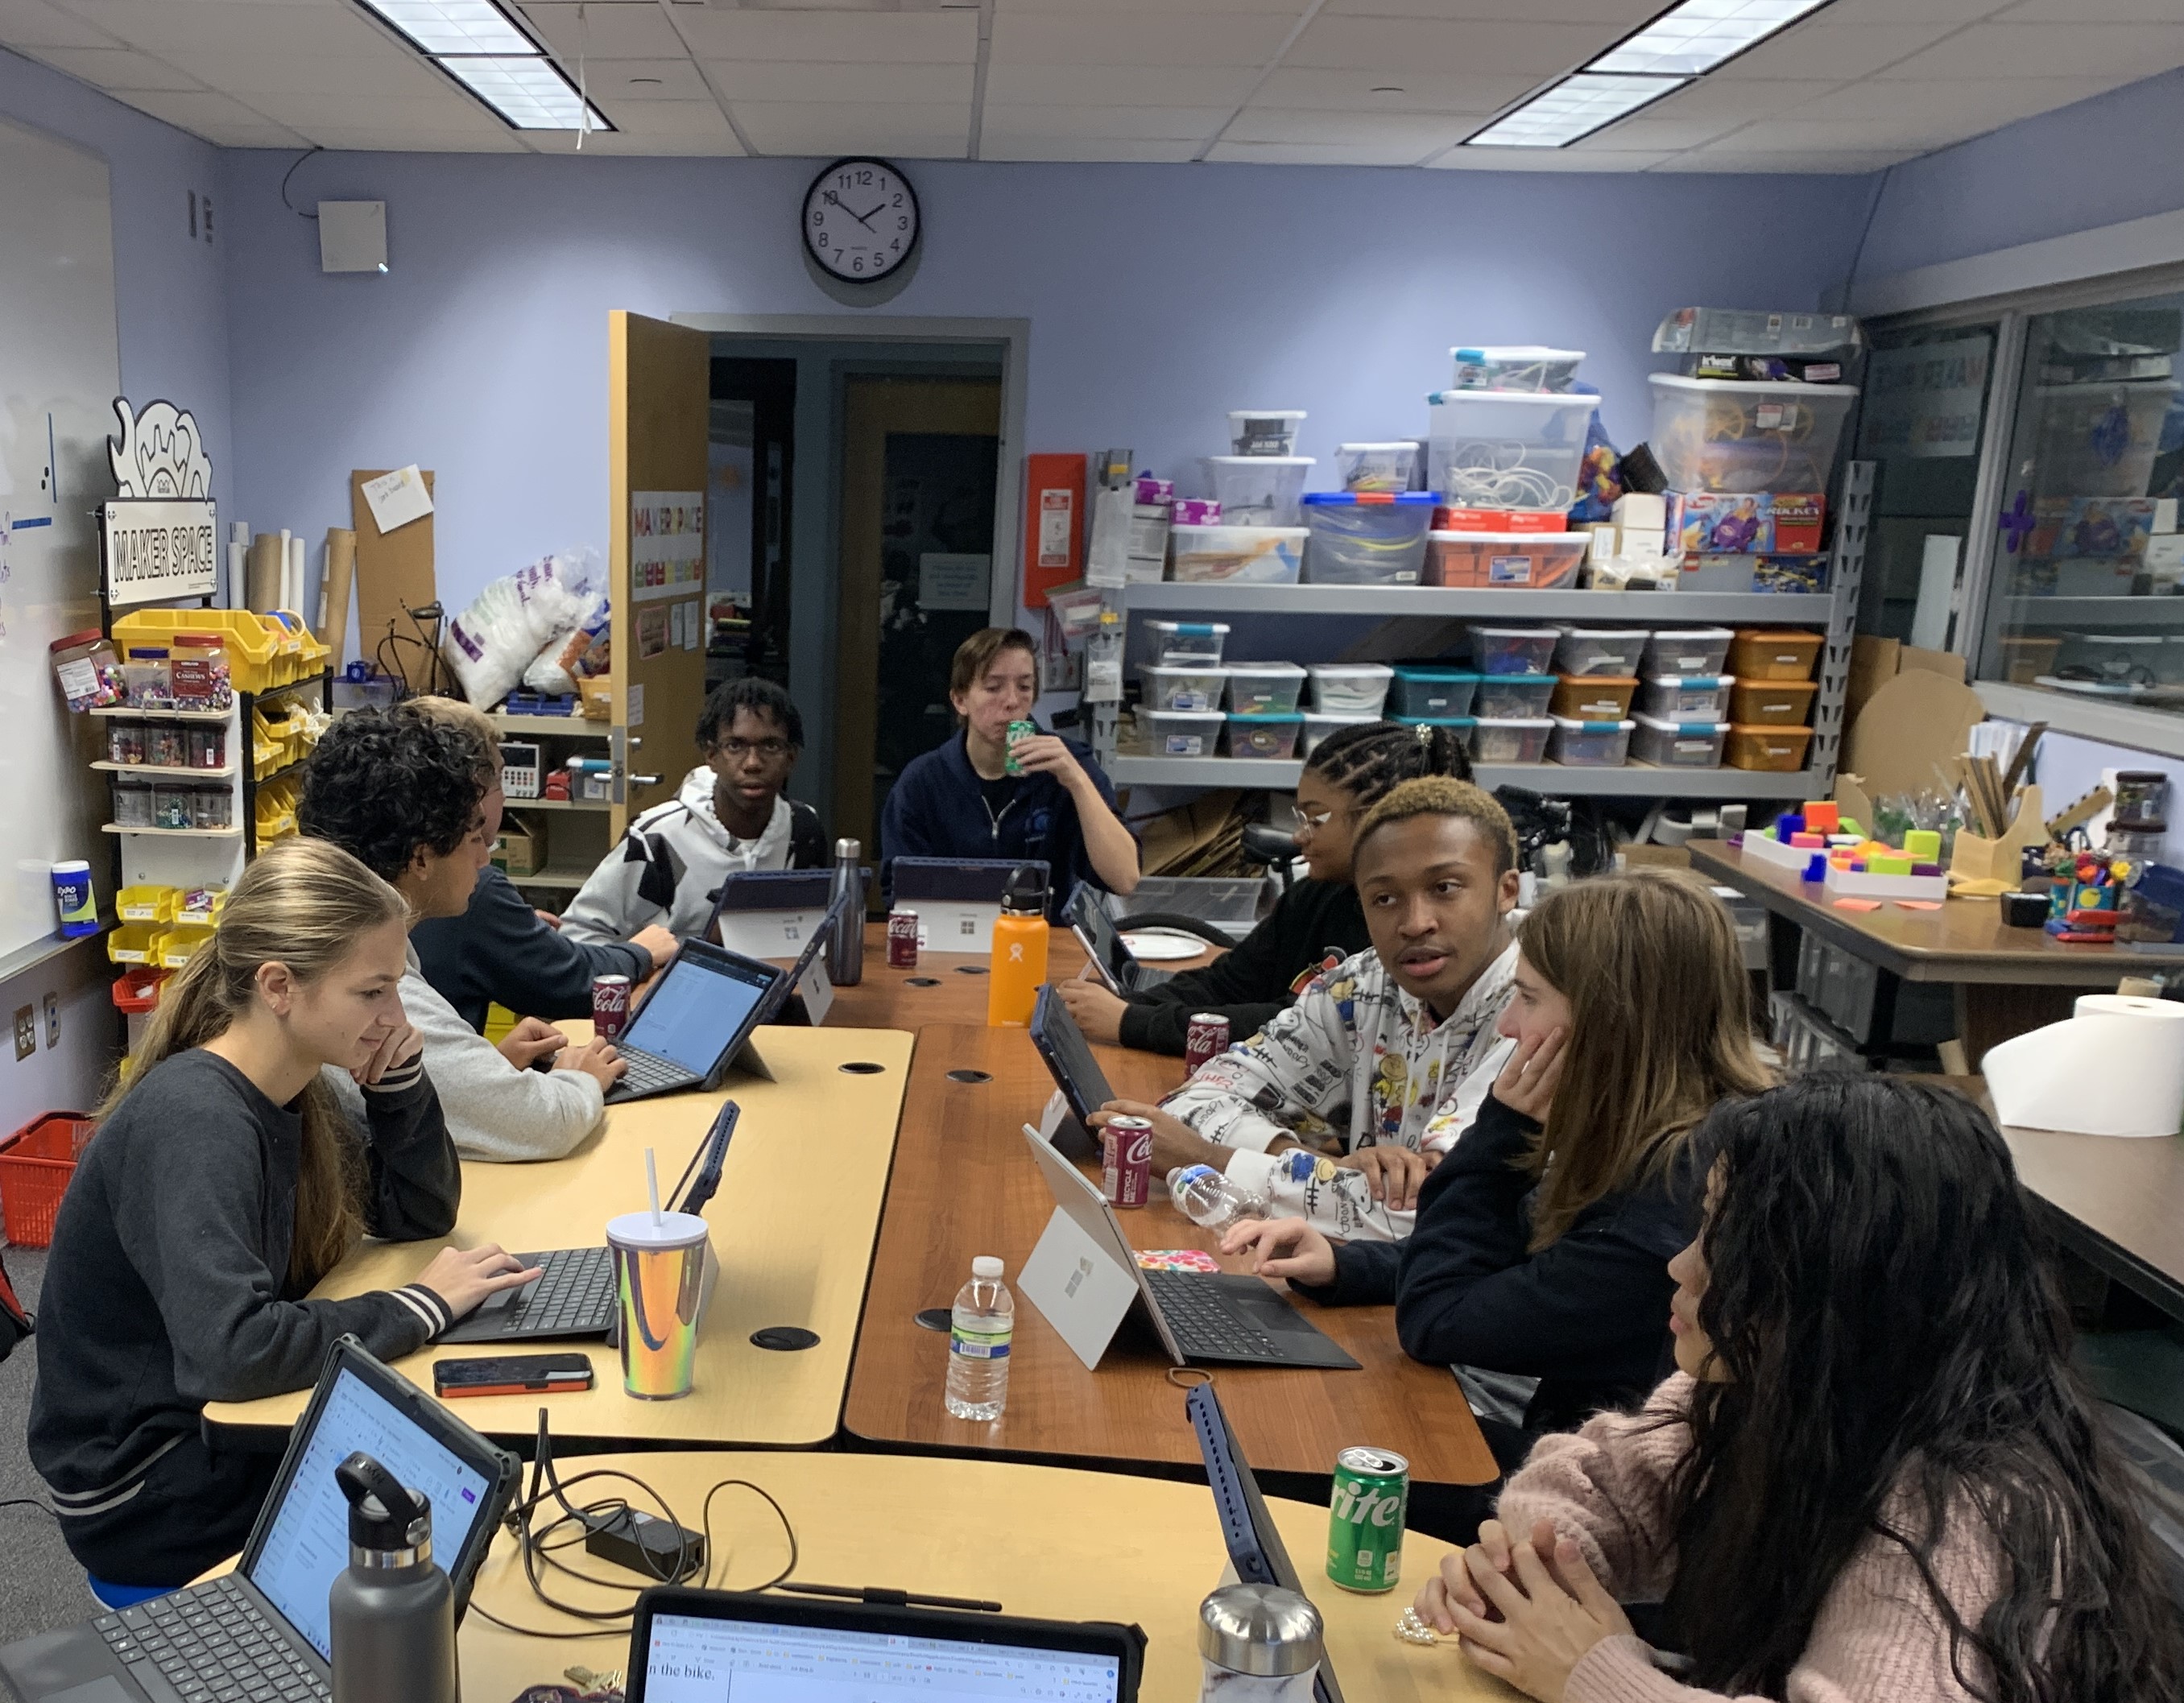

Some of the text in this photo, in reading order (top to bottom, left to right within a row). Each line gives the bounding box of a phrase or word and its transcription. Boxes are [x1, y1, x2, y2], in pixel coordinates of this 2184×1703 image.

[838, 174, 851, 189] 11
[855, 171, 873, 185] 12
[880, 177, 885, 191] 1
[822, 190, 838, 205] 10
[892, 193, 903, 208] 2
[813, 211, 824, 226] 9
[897, 216, 908, 230] 3
[818, 233, 829, 247] 8
[890, 238, 900, 252] 4
[833, 248, 844, 263] 7
[874, 253, 884, 267] 5
[853, 257, 863, 271] 6
[114, 525, 213, 582] MAKER SPACE
[176, 672, 205, 681] CASHEWS
[594, 986, 626, 1012] Cola
[1123, 1169, 1132, 1202] RECYCLE
[661, 1663, 680, 1678] the
[685, 1664, 715, 1681] bike.
